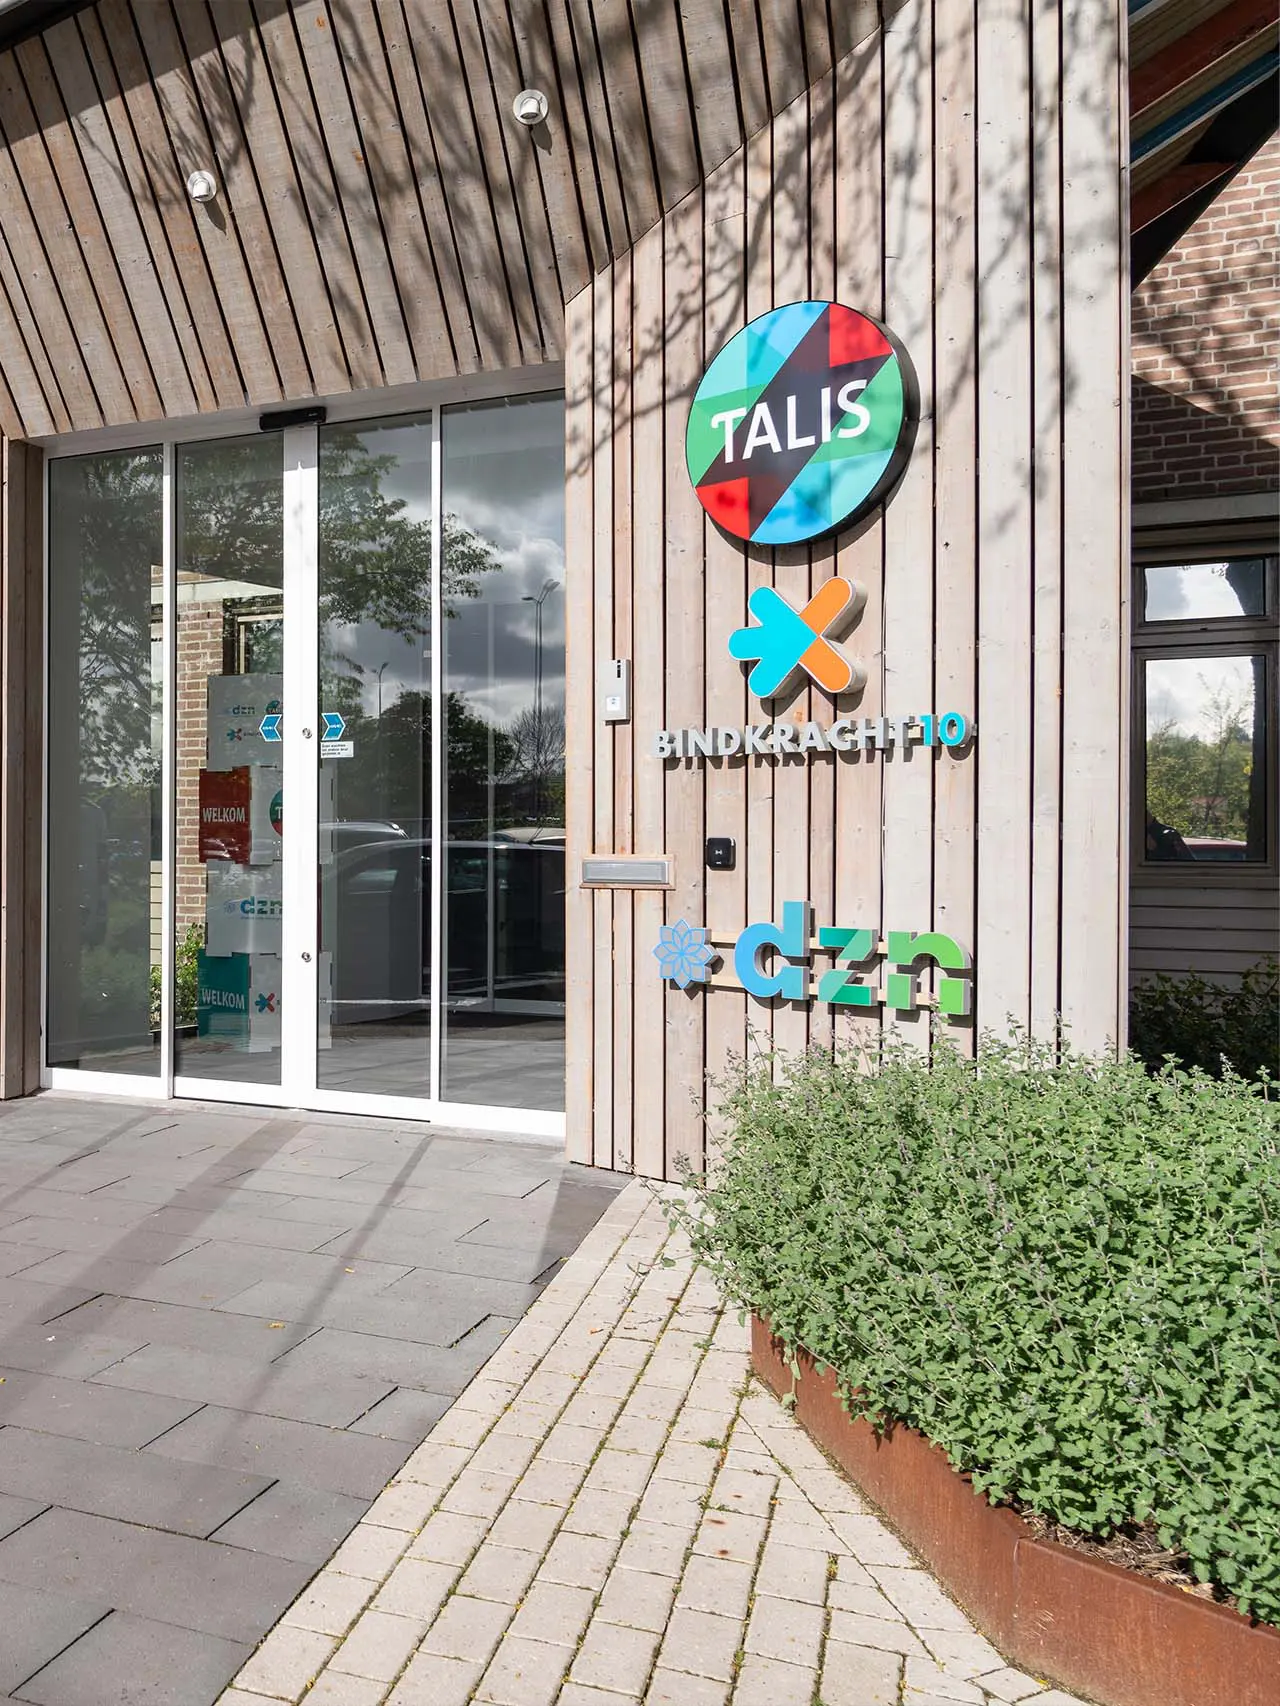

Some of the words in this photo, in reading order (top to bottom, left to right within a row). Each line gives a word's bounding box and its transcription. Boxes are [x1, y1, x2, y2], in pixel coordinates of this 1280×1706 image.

[710, 379, 871, 464] TALIS
[202, 807, 246, 823] WELKOM
[733, 900, 972, 1016] dzn
[201, 987, 245, 1010] WELKOM
